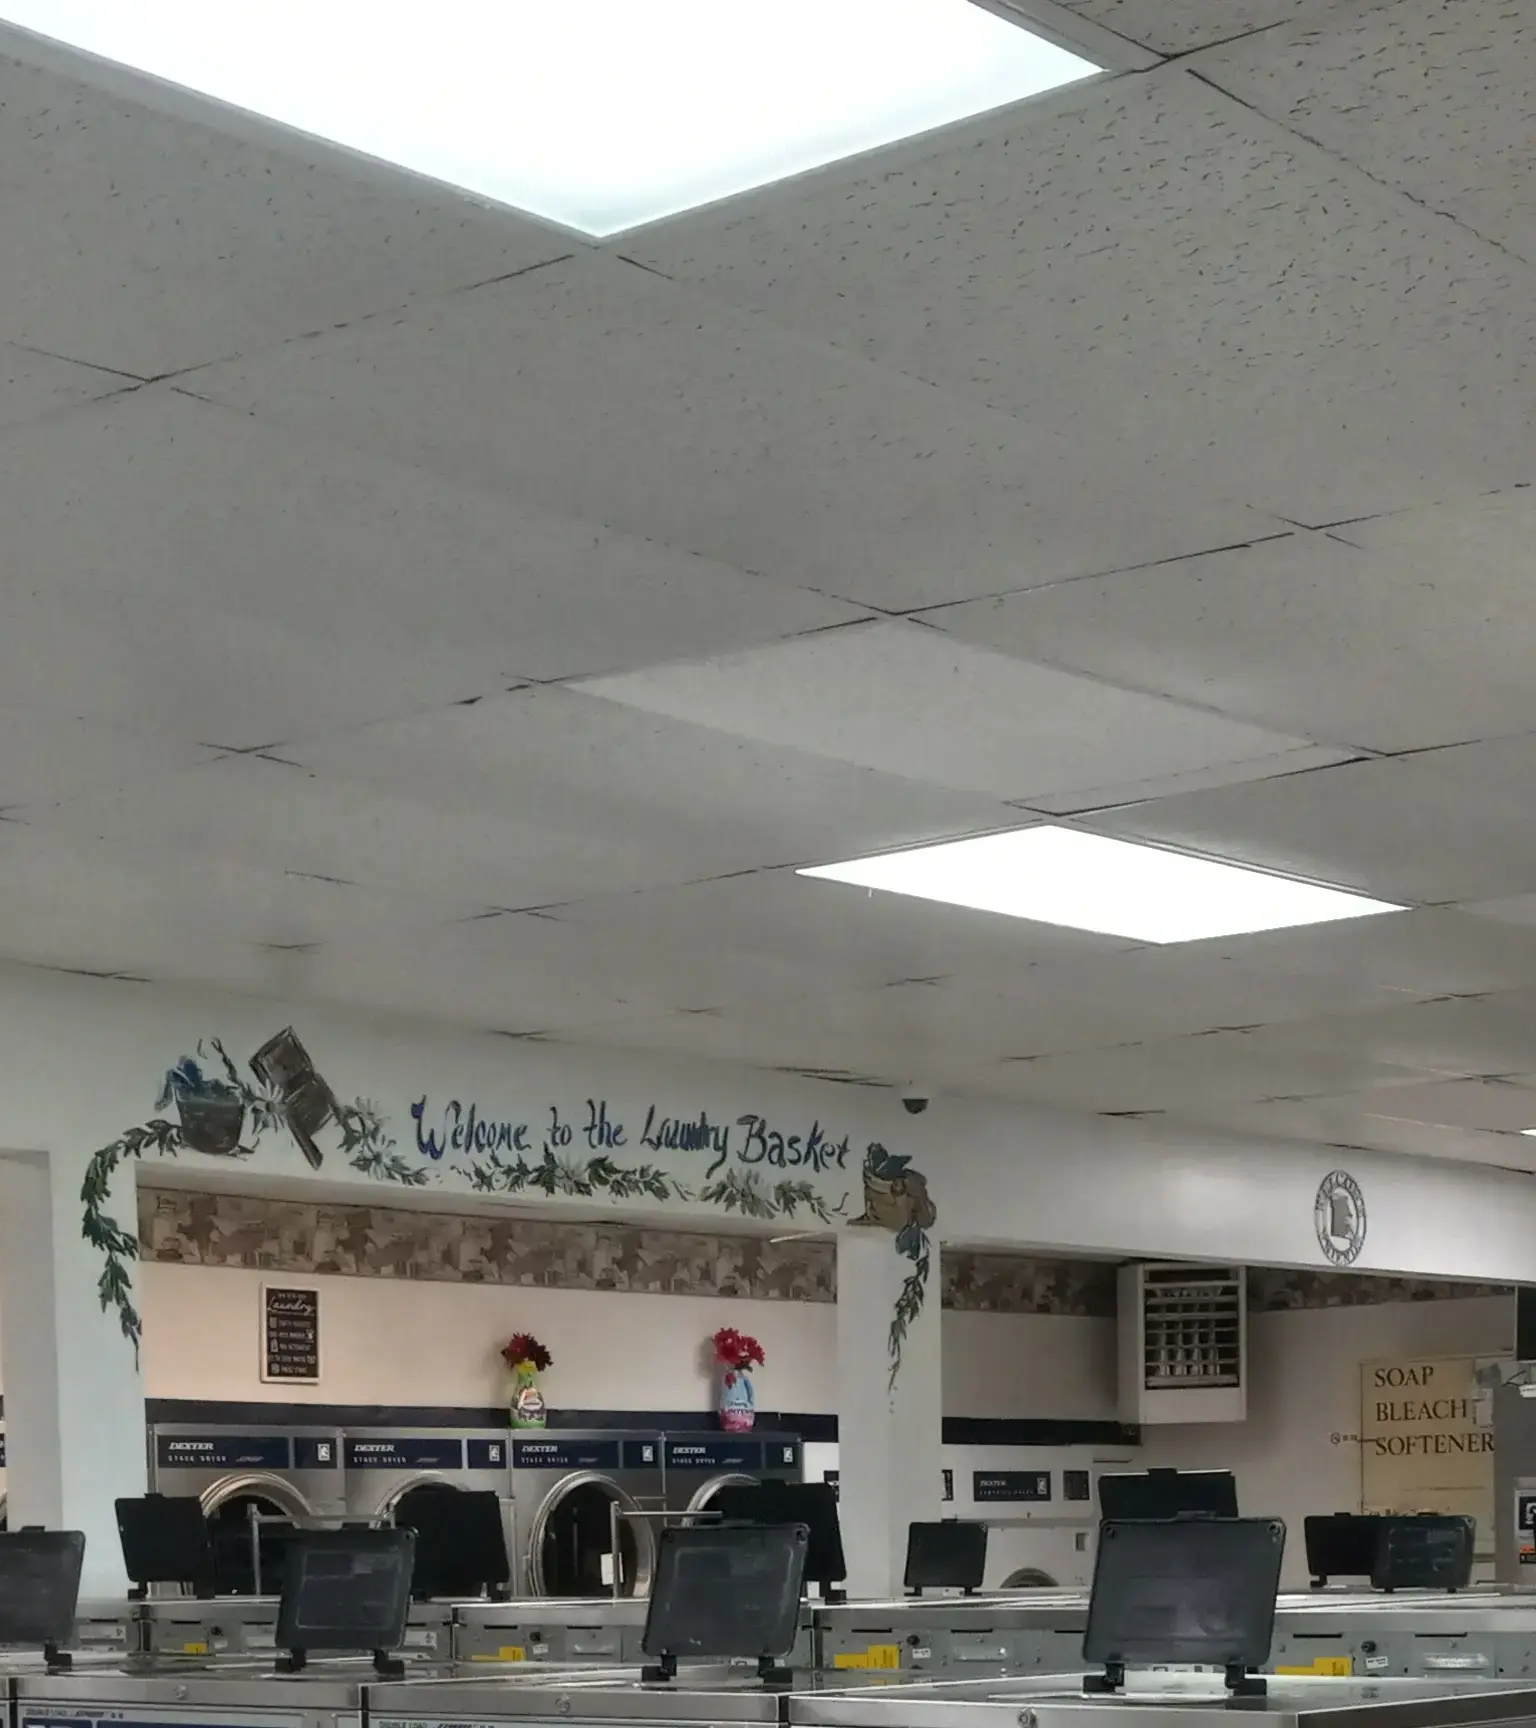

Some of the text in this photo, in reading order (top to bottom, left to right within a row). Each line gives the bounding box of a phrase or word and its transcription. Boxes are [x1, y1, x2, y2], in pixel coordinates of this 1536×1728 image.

[411, 1094, 532, 1160] Welcome
[548, 1106, 572, 1146] to
[587, 1099, 628, 1150] the
[736, 1113, 852, 1173] Basket
[1374, 1366, 1434, 1388] SOAP
[1376, 1398, 1467, 1422] BLEACH
[169, 1442, 214, 1450] DEXTER
[354, 1444, 394, 1452] DEXTER
[1375, 1432, 1496, 1456] SOFTENER
